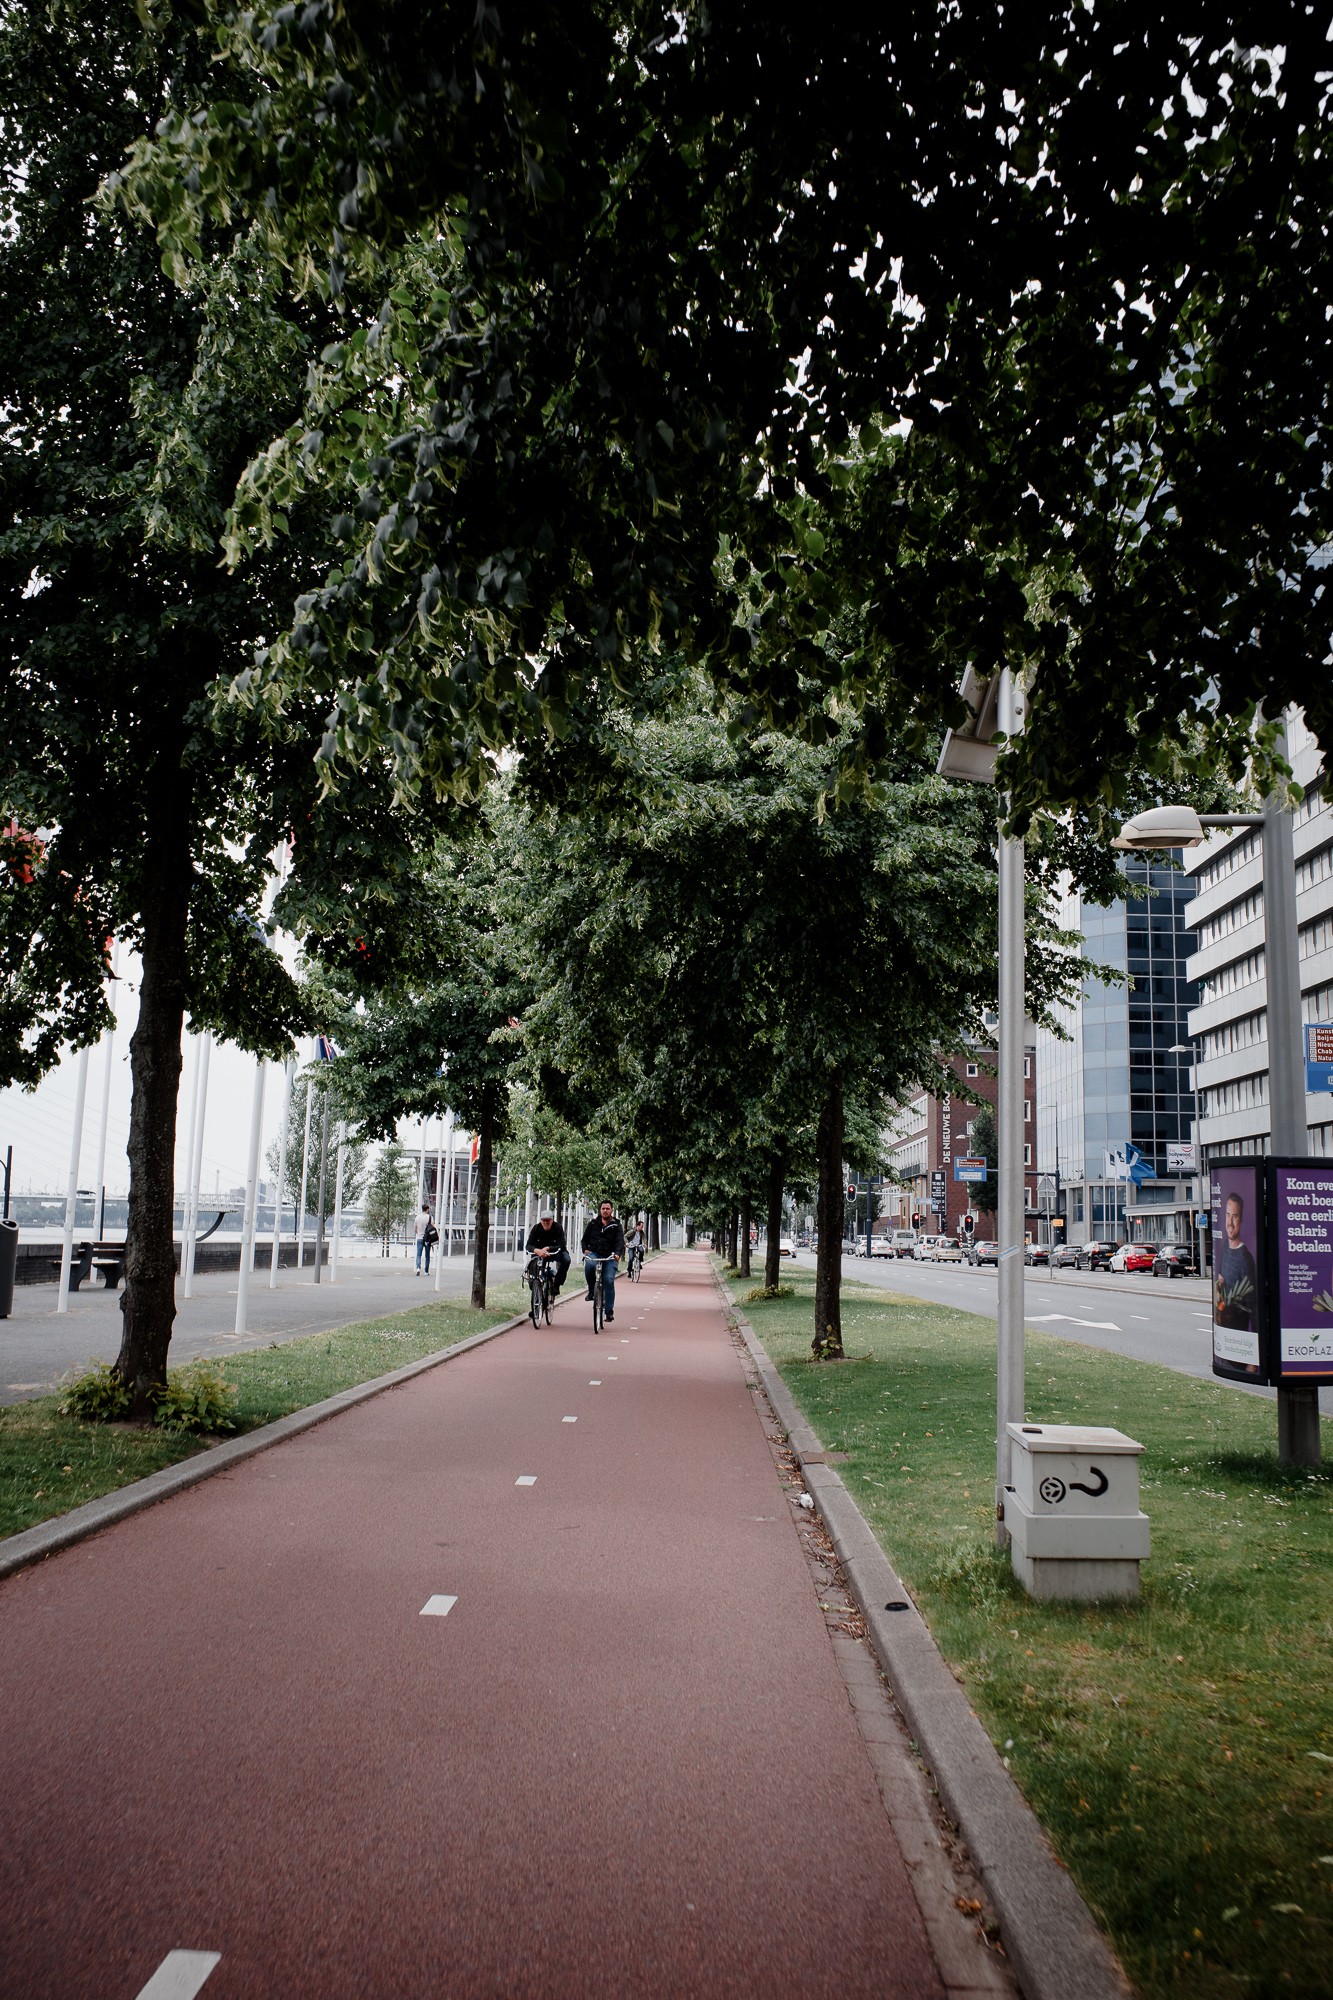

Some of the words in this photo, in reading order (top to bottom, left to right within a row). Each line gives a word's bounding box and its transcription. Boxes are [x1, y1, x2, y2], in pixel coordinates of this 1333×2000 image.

[943, 1151, 950, 1163] DE
[1286, 1177, 1315, 1190] Kom
[1286, 1194, 1311, 1206] wat
[1287, 1211, 1310, 1221] een
[1287, 1224, 1327, 1237] salaris
[1287, 1239, 1332, 1252] betalen
[1288, 1346, 1333, 1356] EKOPLAZ
